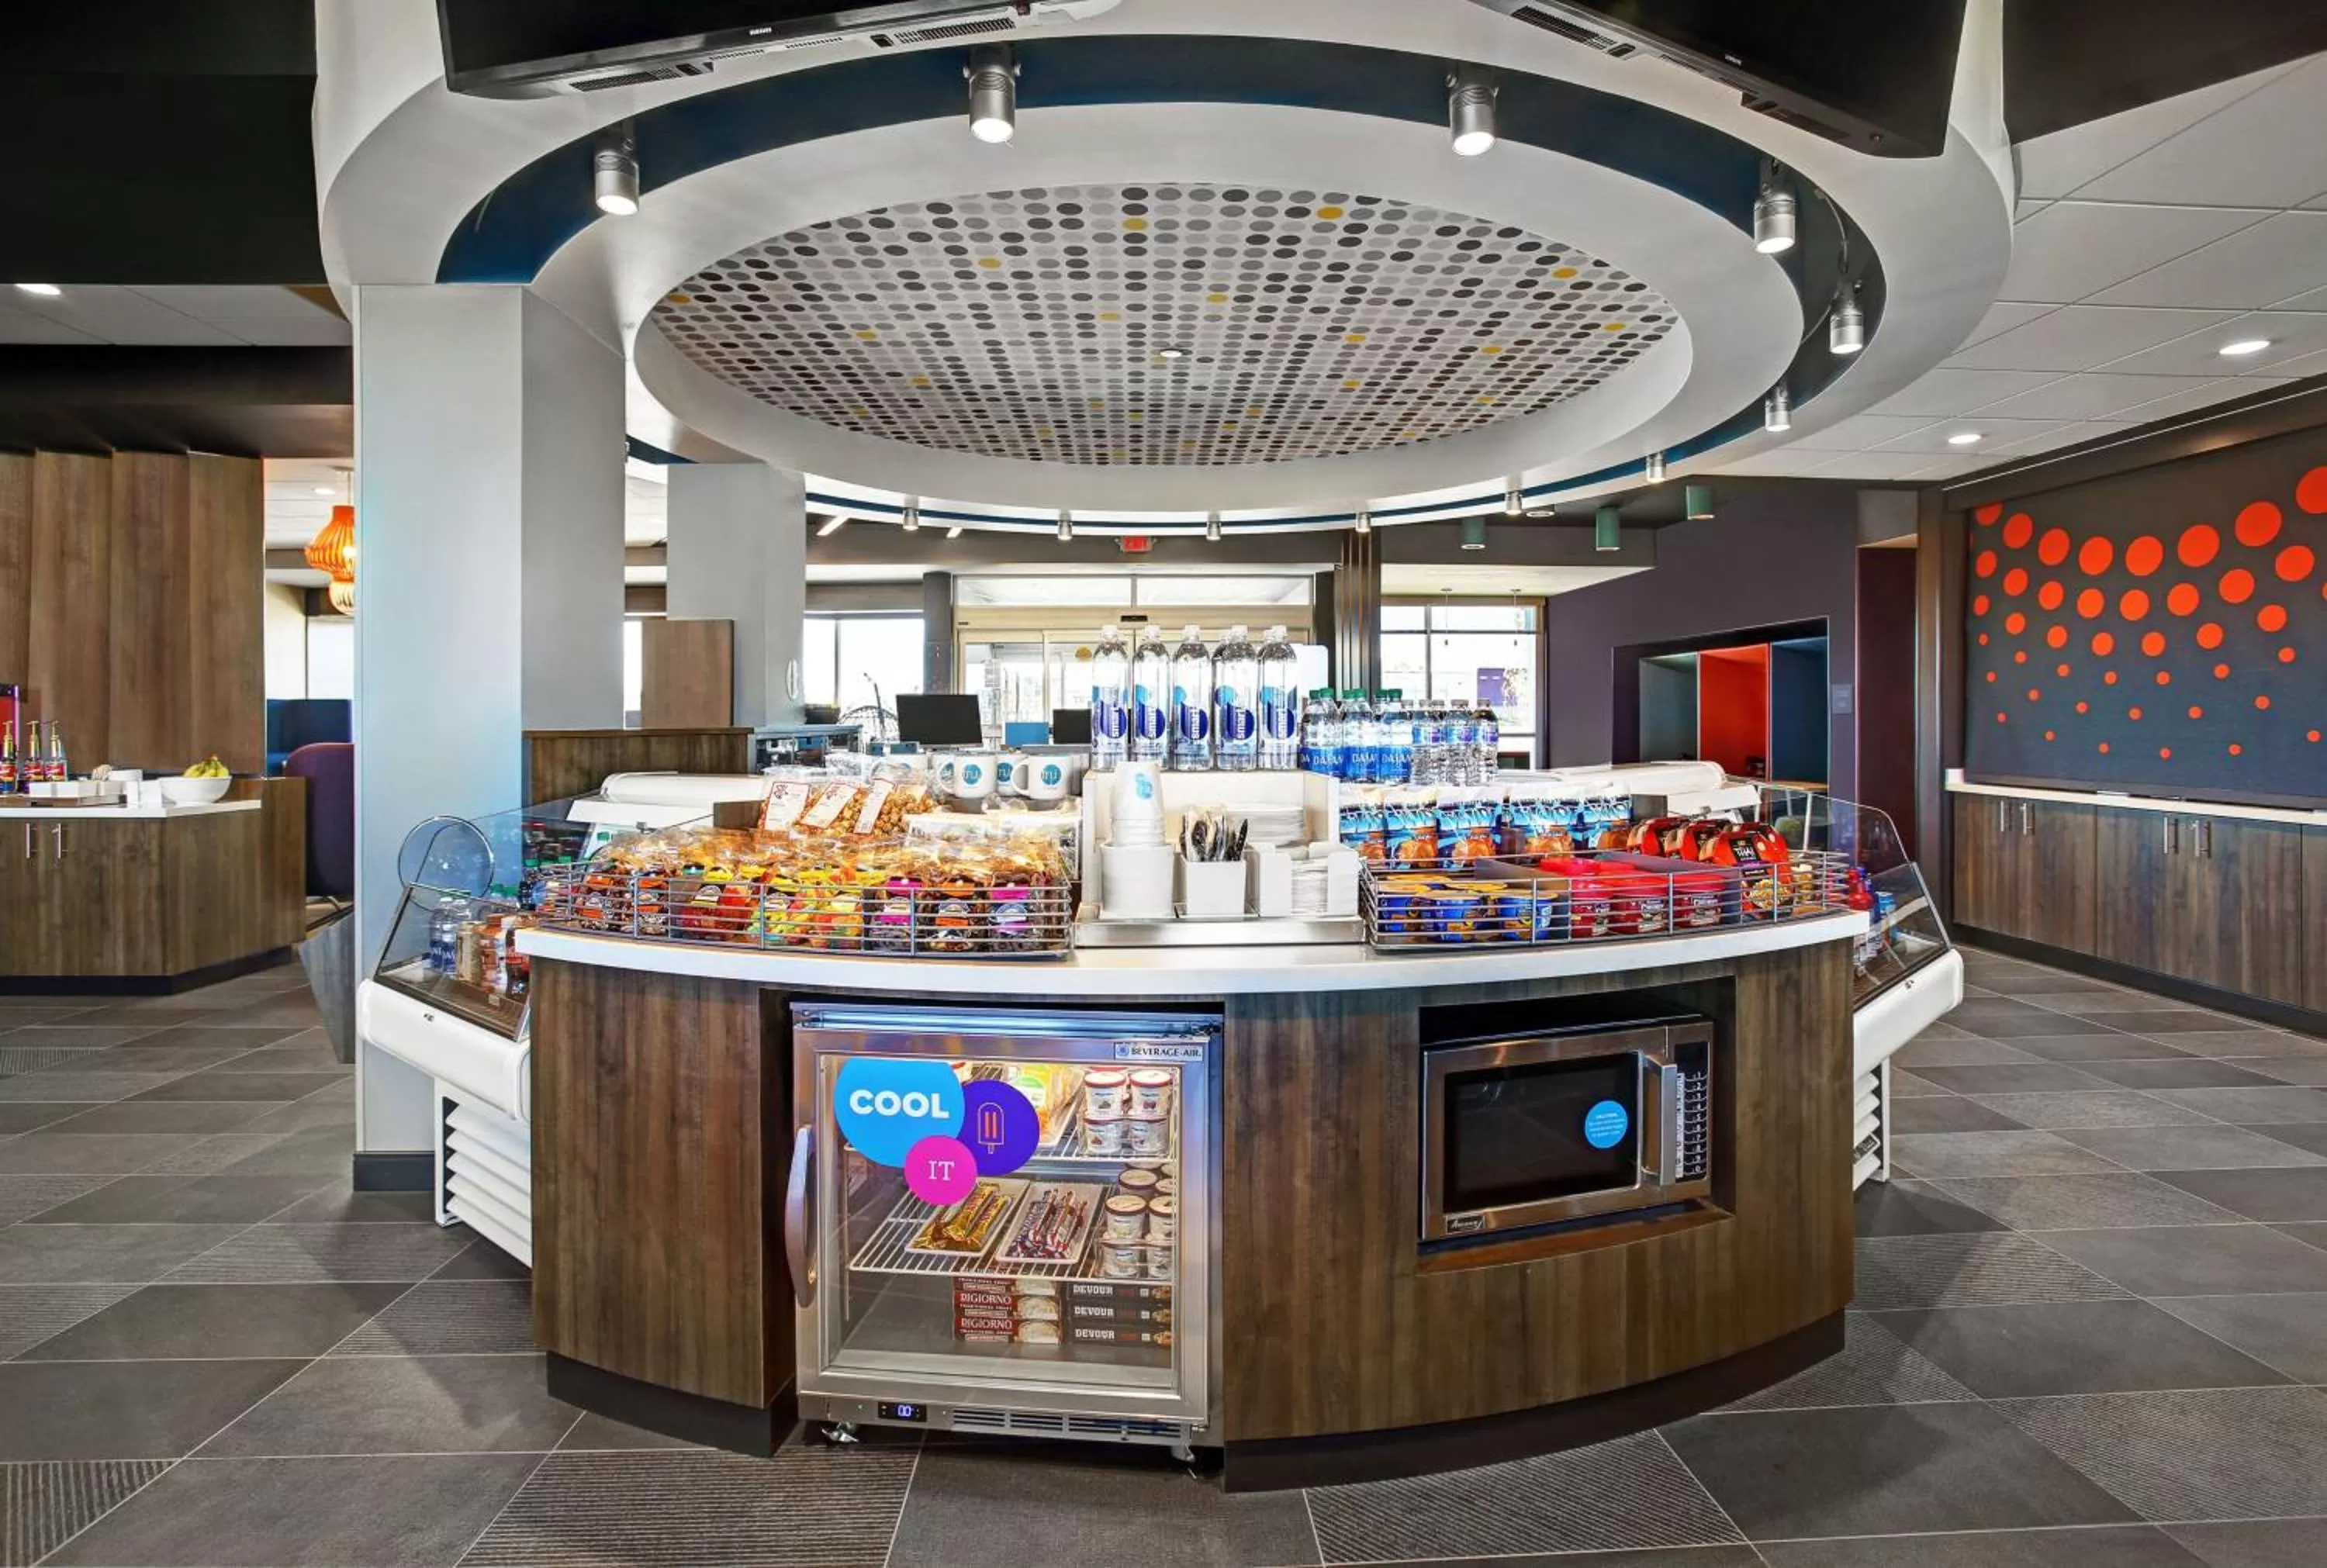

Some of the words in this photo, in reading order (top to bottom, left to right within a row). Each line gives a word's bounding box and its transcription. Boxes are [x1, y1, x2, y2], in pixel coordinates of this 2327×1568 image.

[1190, 707, 1199, 738] smart
[1236, 707, 1246, 738] smart
[849, 1089, 949, 1118] COOL
[928, 1160, 955, 1181] IT
[1073, 1284, 1113, 1295] DEVOUR
[1074, 1306, 1114, 1316] DEVOUR
[1075, 1328, 1115, 1339] DEVOUR
